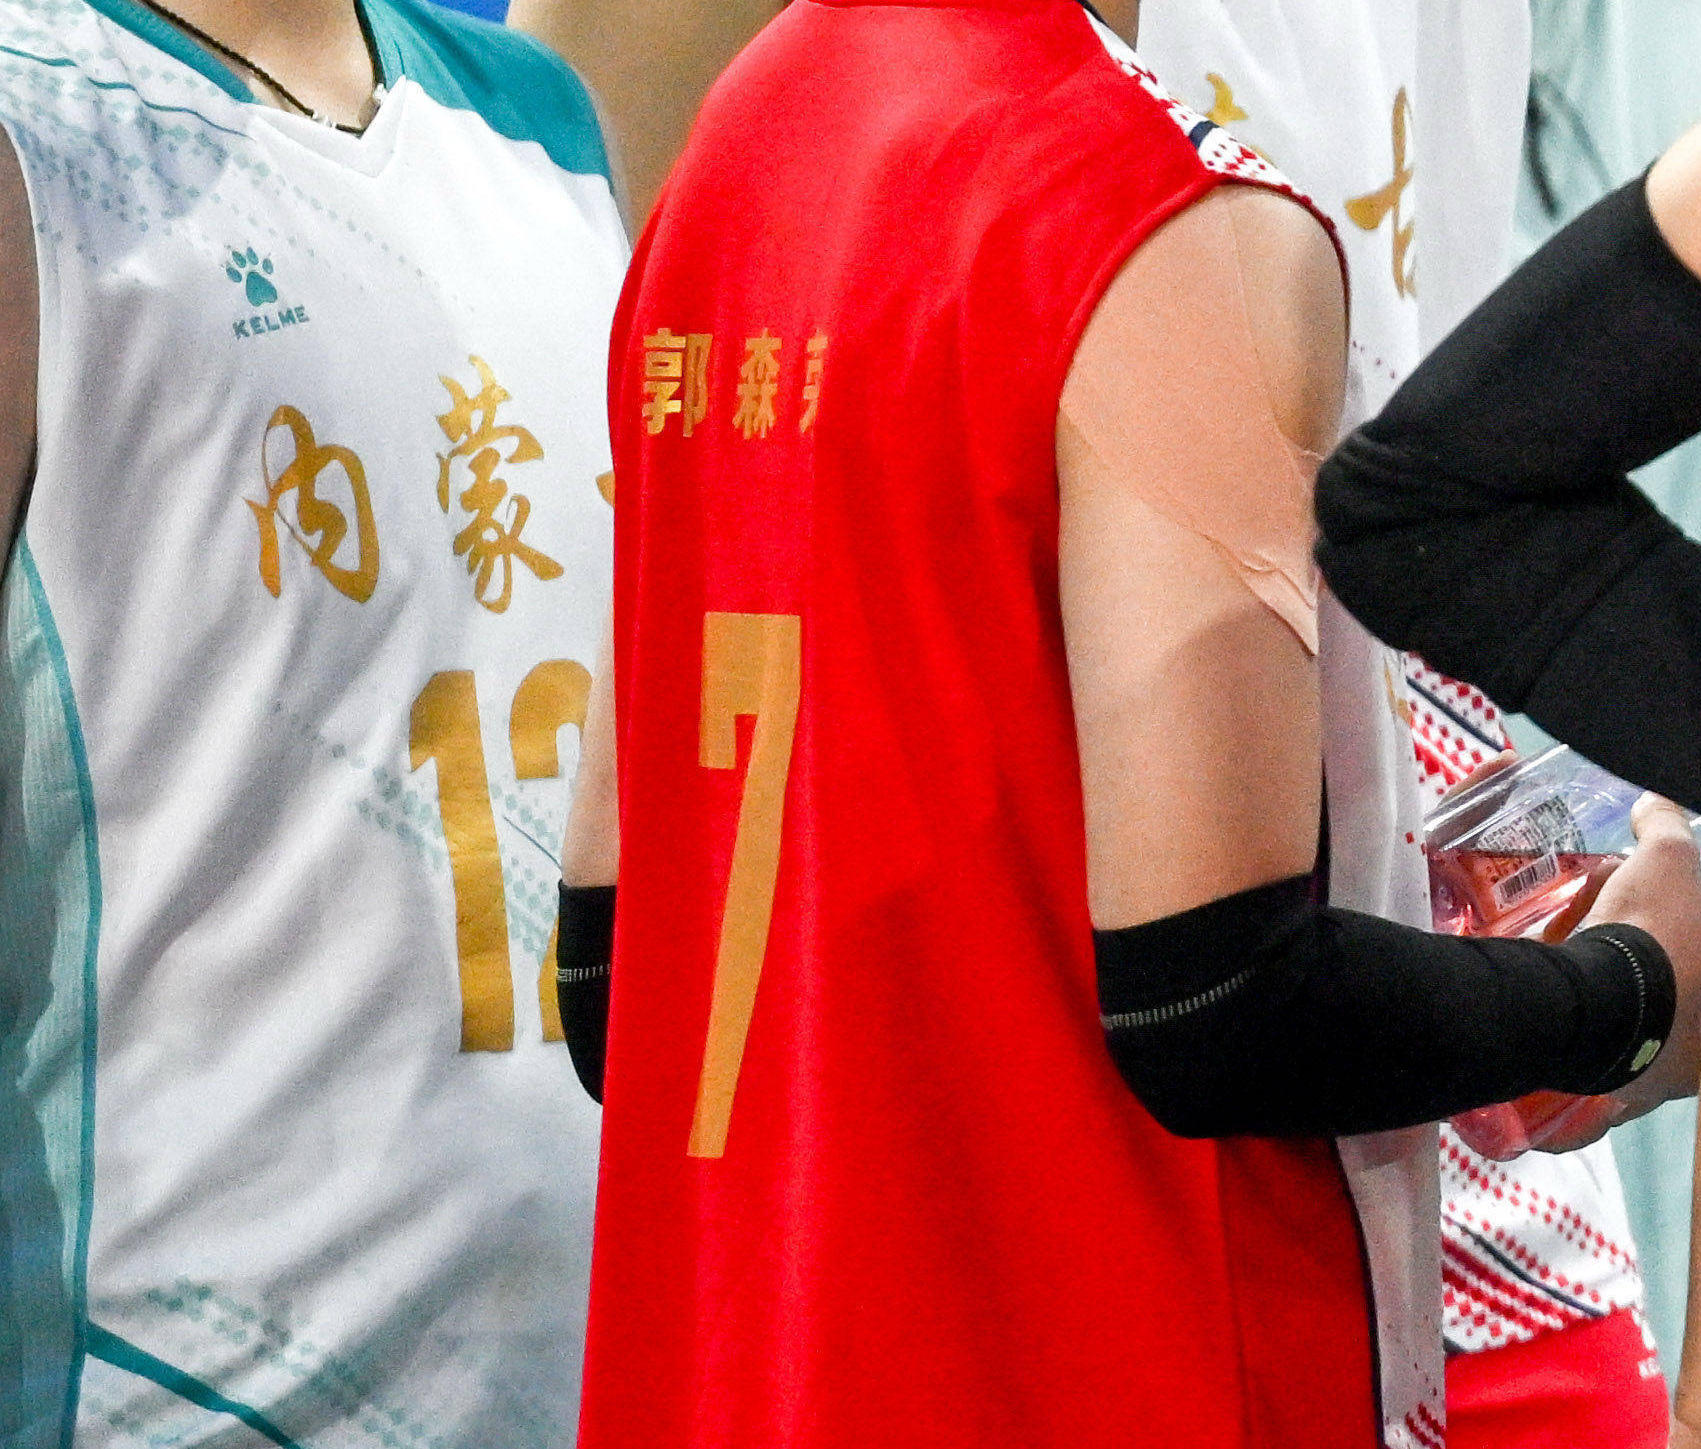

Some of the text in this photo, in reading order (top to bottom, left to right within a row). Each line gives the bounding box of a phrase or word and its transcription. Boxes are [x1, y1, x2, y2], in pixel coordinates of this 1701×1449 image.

[232, 304, 310, 341] KELME
[243, 354, 616, 615] 内蒙
[687, 610, 802, 1159] 7
